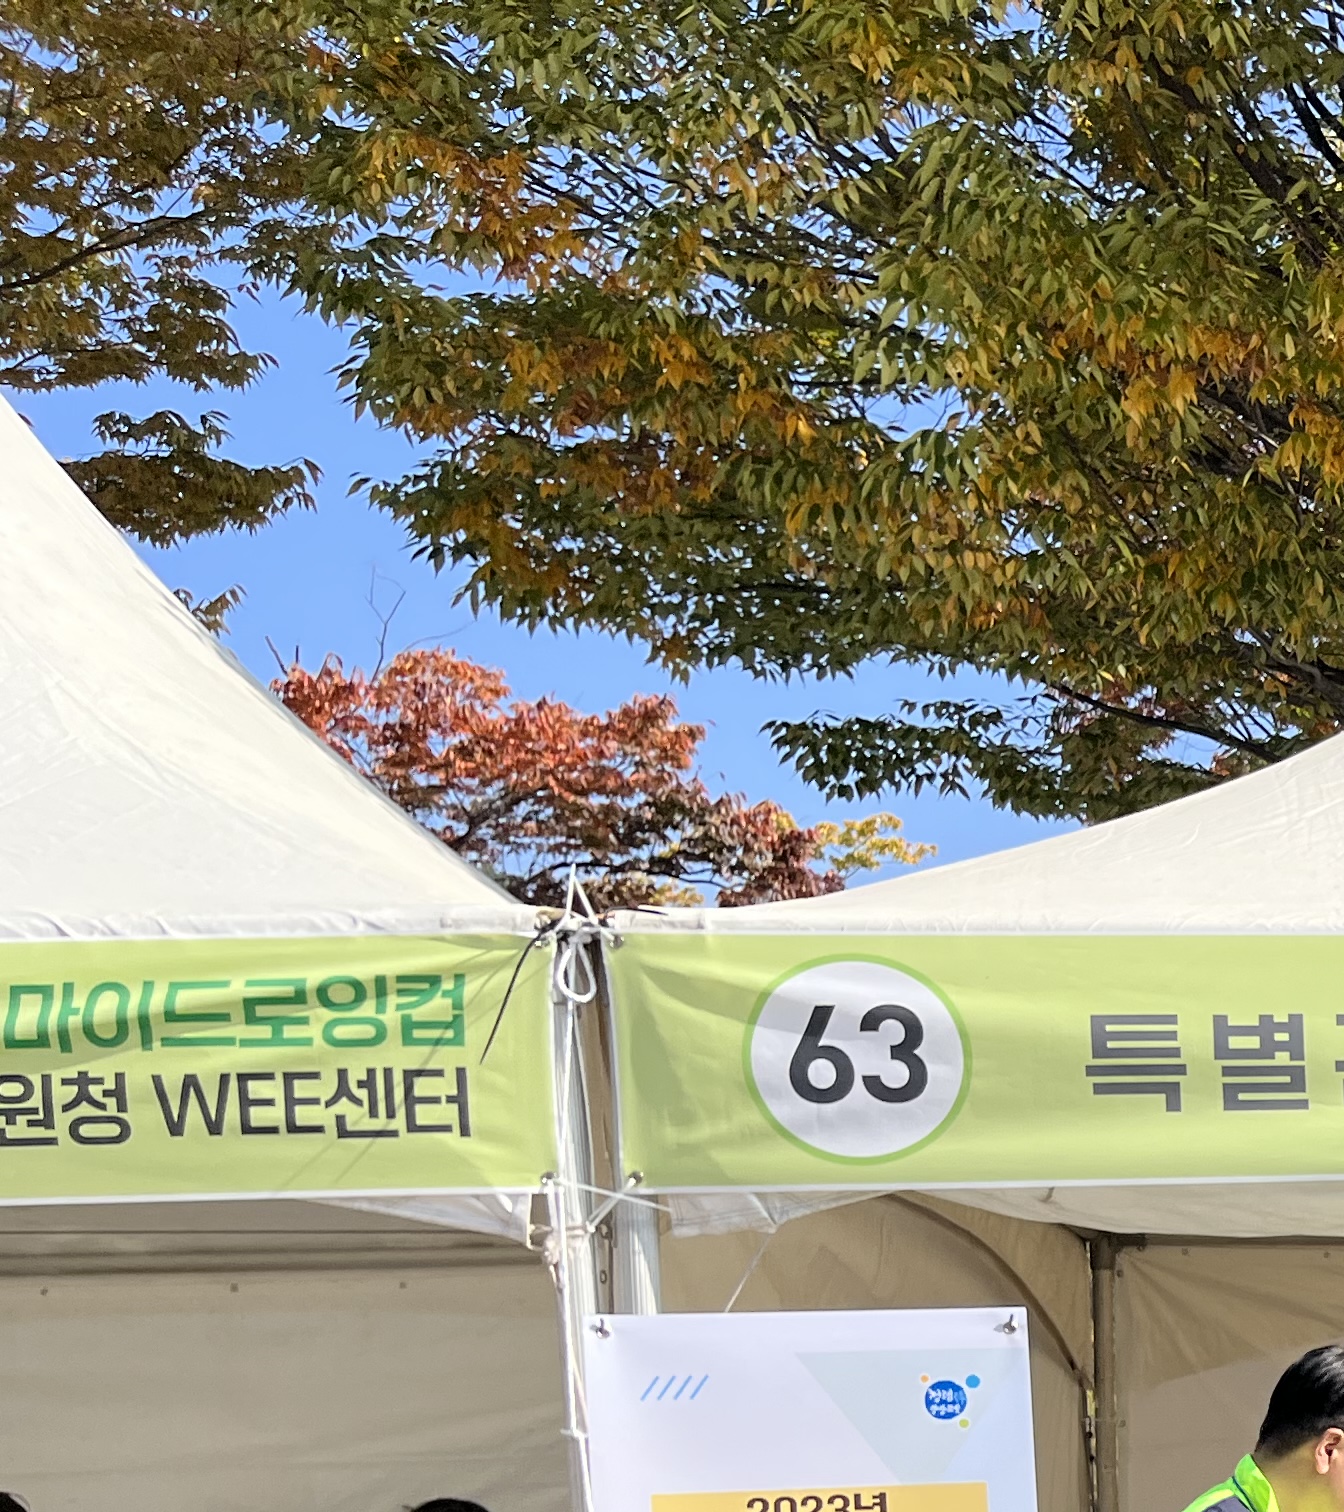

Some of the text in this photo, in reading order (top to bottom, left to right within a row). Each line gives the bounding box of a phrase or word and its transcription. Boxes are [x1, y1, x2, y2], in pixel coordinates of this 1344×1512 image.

[3, 973, 466, 1053] 마이드로잉컵
[787, 1003, 929, 1105] 63
[150, 1066, 471, 1140] WEE센터
